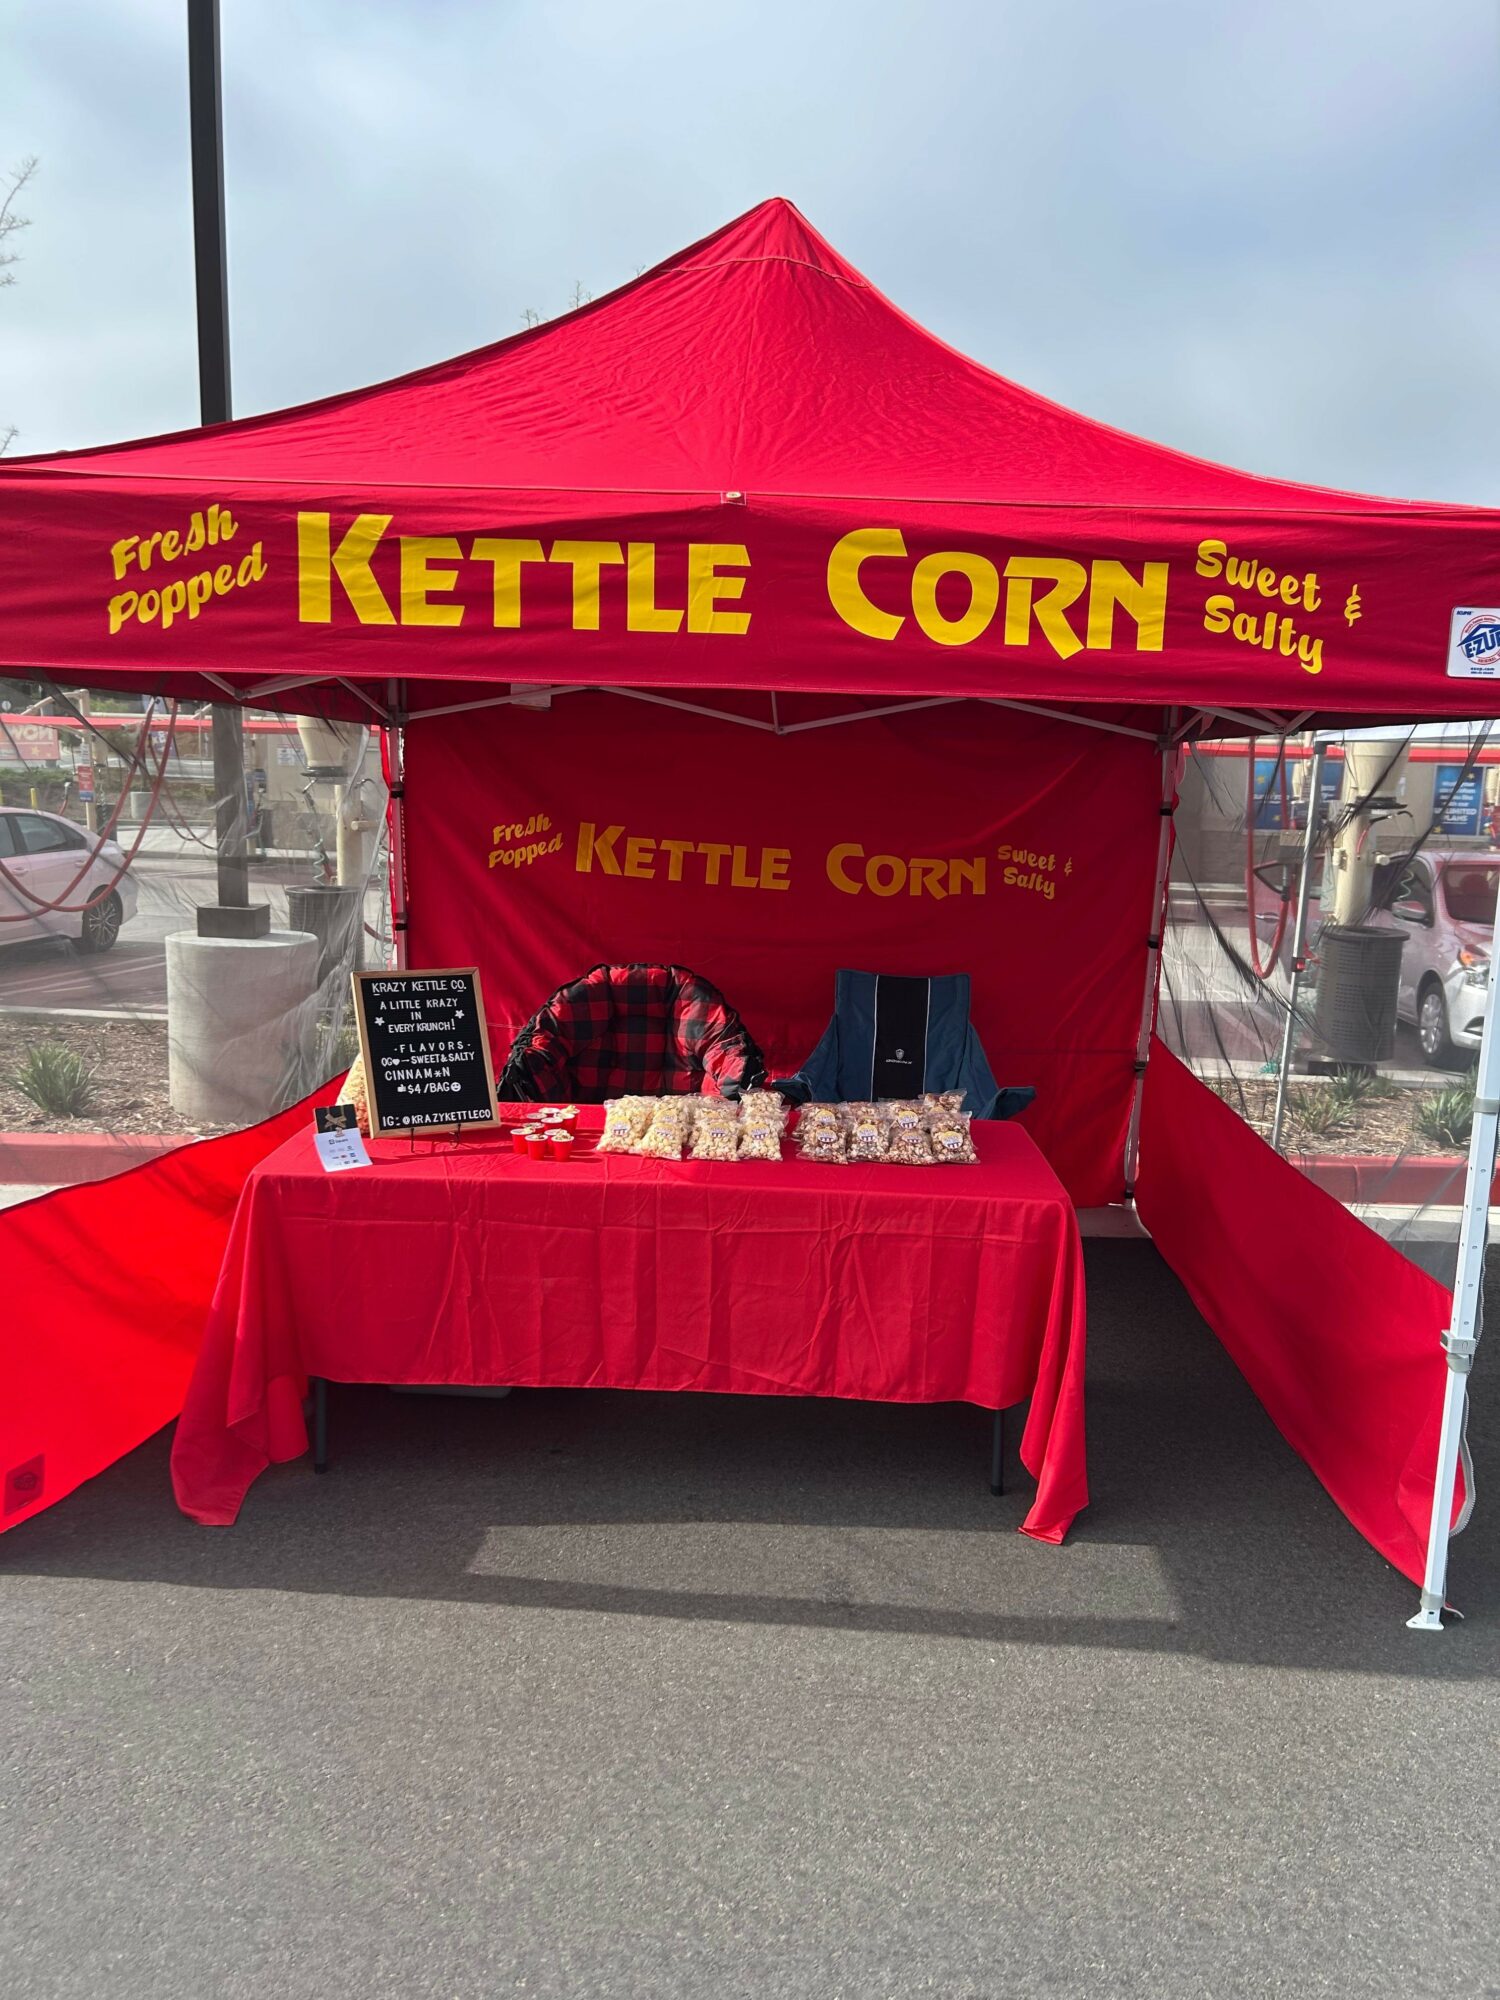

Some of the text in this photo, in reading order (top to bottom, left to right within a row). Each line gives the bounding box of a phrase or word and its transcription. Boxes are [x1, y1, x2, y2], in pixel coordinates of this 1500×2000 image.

[111, 504, 238, 580] Fresh
[107, 541, 267, 635] Popped
[297, 511, 1169, 660] KETTLE CORN
[1195, 539, 1363, 628] Sweet &
[1203, 594, 1325, 675] Salty
[492, 813, 551, 845] Fresh
[488, 832, 563, 869] Popped
[575, 822, 986, 900] KETTLE CORN
[997, 845, 1056, 872] Sweet
[1003, 867, 1055, 900] Salty
[371, 979, 467, 993] KRAZY KETTLE CO.
[380, 998, 458, 1010] A LITTLE KRAZY
[410, 1011, 422, 1020] IN
[388, 1023, 415, 1033] EVERY
